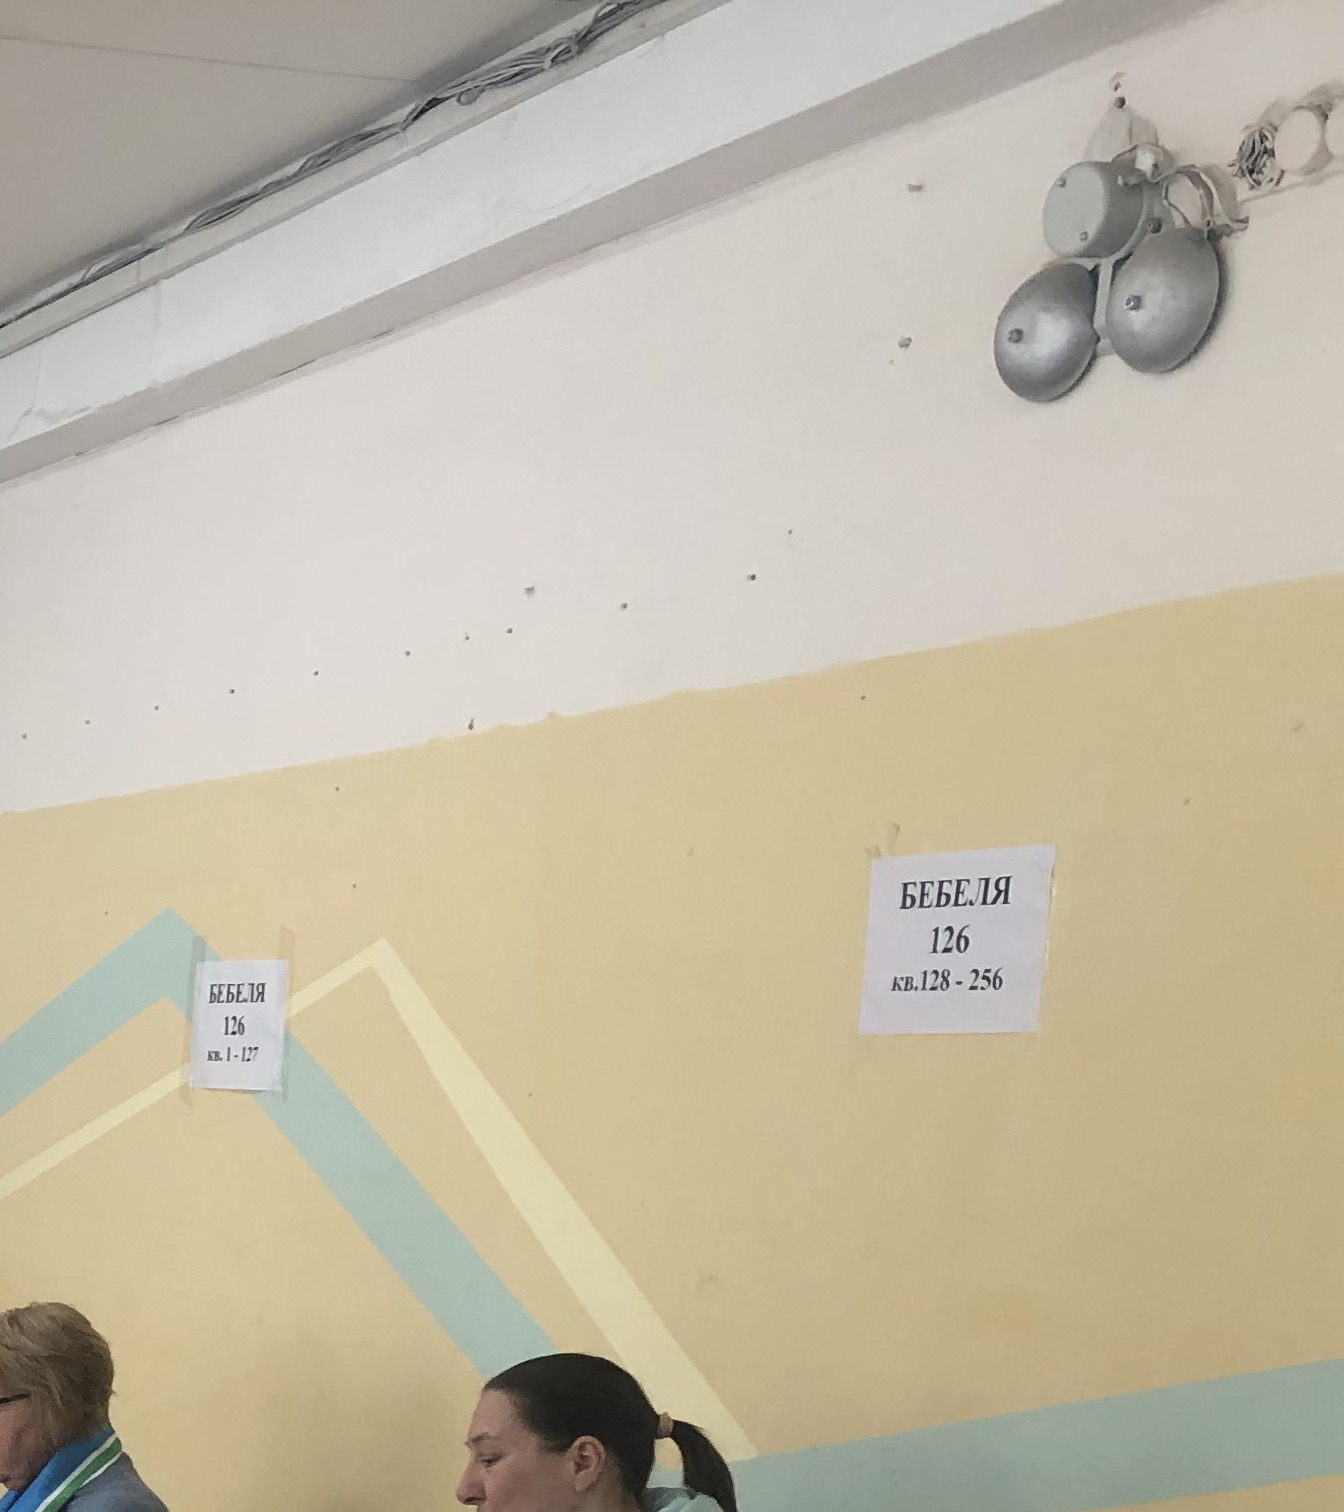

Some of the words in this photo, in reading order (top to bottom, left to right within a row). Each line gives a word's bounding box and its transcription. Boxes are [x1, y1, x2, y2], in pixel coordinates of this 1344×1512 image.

[899, 874, 1013, 910] БЕБЕЛЯ
[928, 924, 972, 954] 126
[890, 968, 952, 992] кв.128
[967, 967, 1004, 991] 256
[208, 982, 267, 1004] БЕБЕЛЯ
[223, 1015, 246, 1036] 126
[206, 1050, 223, 1062] кв.
[226, 1046, 231, 1062] 1
[241, 1046, 259, 1062] 127
